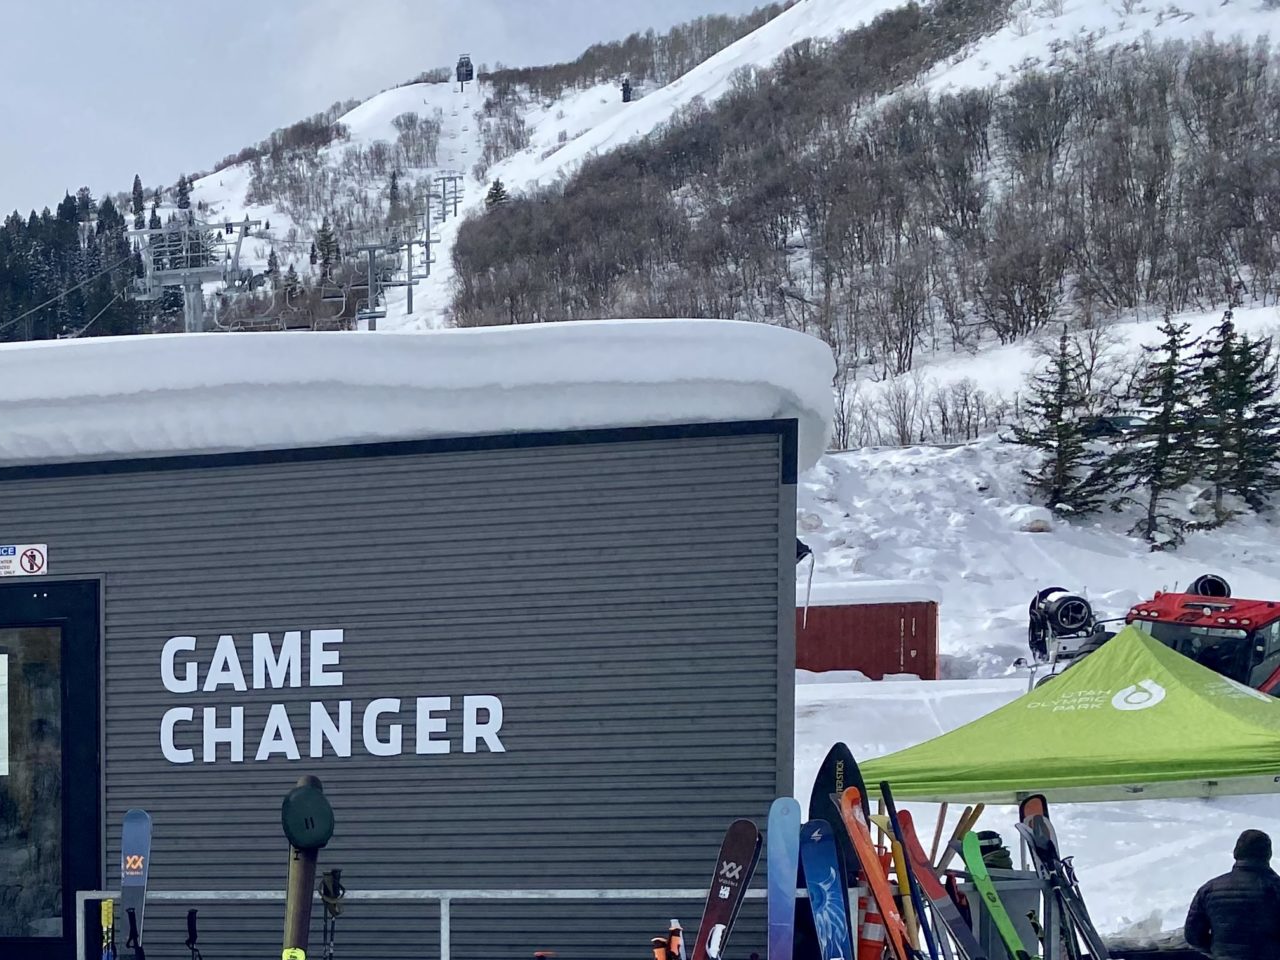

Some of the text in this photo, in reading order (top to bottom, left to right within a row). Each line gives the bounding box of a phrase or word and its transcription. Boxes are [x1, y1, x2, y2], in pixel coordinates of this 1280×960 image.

[160, 628, 344, 693] GAME
[1027, 695, 1107, 709] OLYMPIC
[1062, 689, 1112, 699] UTAH
[1052, 703, 1103, 713] PARK
[160, 694, 506, 764] CHANGER
[835, 760, 844, 794] TERSTICK
